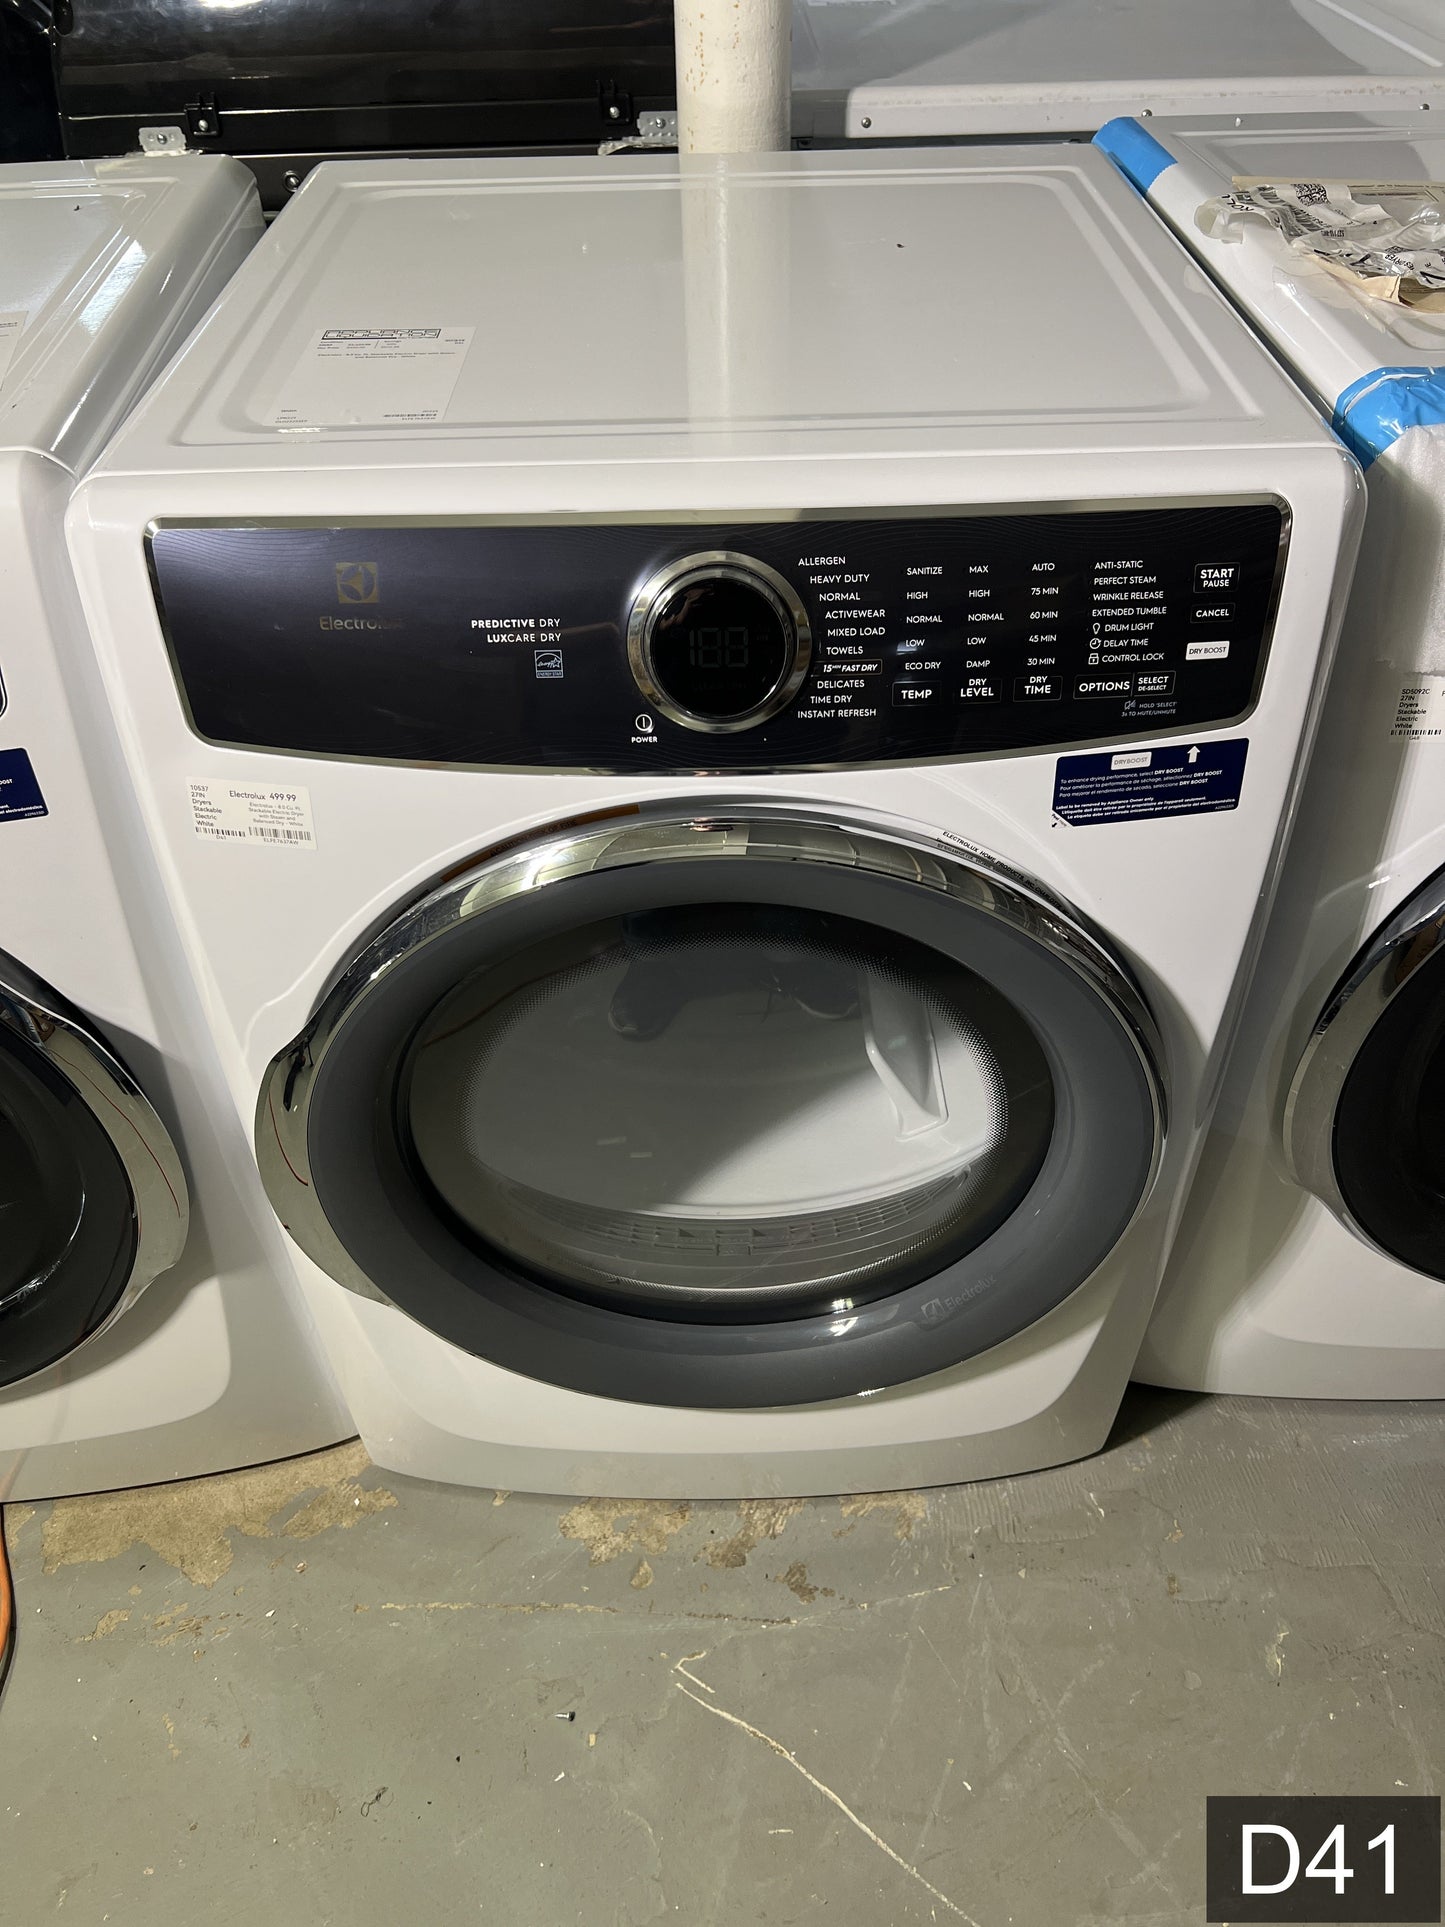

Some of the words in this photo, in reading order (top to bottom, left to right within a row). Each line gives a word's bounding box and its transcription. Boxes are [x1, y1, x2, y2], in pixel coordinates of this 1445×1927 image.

[798, 557, 846, 566] ALLERGEN
[1095, 560, 1143, 570] ANTI-STATIC
[907, 567, 942, 575] SANITIZE
[969, 565, 988, 574] MAX
[1032, 563, 1055, 571] AUTO
[1201, 568, 1234, 579] START
[810, 576, 841, 584] HEAVY
[844, 574, 870, 582] DUTY
[1094, 577, 1127, 585] PERFECT
[1128, 576, 1156, 584] STEAM
[1203, 579, 1229, 587] PAUSE
[969, 590, 990, 598] HIGH
[1031, 587, 1040, 595] 75
[1042, 587, 1059, 595] MIN
[820, 592, 860, 601] NORMAL
[1093, 592, 1128, 601] WRINKLE
[1130, 591, 1164, 599] RELEASE
[825, 610, 885, 619] ACTIVEWEAR
[1030, 611, 1040, 619] 60
[1042, 611, 1058, 619] MIN
[1092, 608, 1134, 617] EXTENDED
[1136, 607, 1167, 615] TUMBLE
[1196, 609, 1229, 618] CANCEL
[906, 615, 942, 623] NORMAL
[968, 612, 1004, 622] NORMAL
[471, 619, 535, 629] PREDICTIVE
[539, 618, 560, 627] DRY
[1105, 624, 1129, 632] DRUM
[1130, 622, 1154, 631] LIGHT
[860, 627, 885, 635] LOAD
[487, 634, 535, 643] LUXCARE
[541, 633, 561, 642] DRY
[967, 637, 986, 645] LOW
[1029, 635, 1039, 643] 45
[1041, 634, 1056, 642] MIN
[906, 639, 925, 647] LOW
[1103, 639, 1129, 648] DELAY
[826, 646, 863, 655] TOWELS
[1204, 646, 1226, 654] BOOST
[1027, 658, 1037, 666] 30
[1039, 657, 1055, 666] MIN
[1102, 655, 1140, 663] CONTROL
[1142, 653, 1164, 661] LOCK
[905, 662, 923, 670] ECO
[925, 662, 941, 670] DRY
[966, 660, 990, 668] DAMP
[817, 680, 865, 689] DELICATES
[969, 678, 986, 686] DRY
[1030, 676, 1048, 684] DRY
[1138, 676, 1169, 684] SELECT
[1025, 685, 1051, 694] TIME
[1079, 681, 1130, 692] OPTIONS
[902, 690, 932, 699] TEMP
[960, 688, 994, 697] LEVEL
[834, 695, 852, 703] DRY
[798, 710, 835, 718] INSTANT
[838, 709, 876, 717] REFRESH
[229, 790, 266, 800] Electrolux
[269, 794, 296, 802] 499.99
[942, 831, 979, 852] ELECTROLUX
[980, 851, 996, 862] HOME
[944, 1273, 997, 1309] Electrolux
